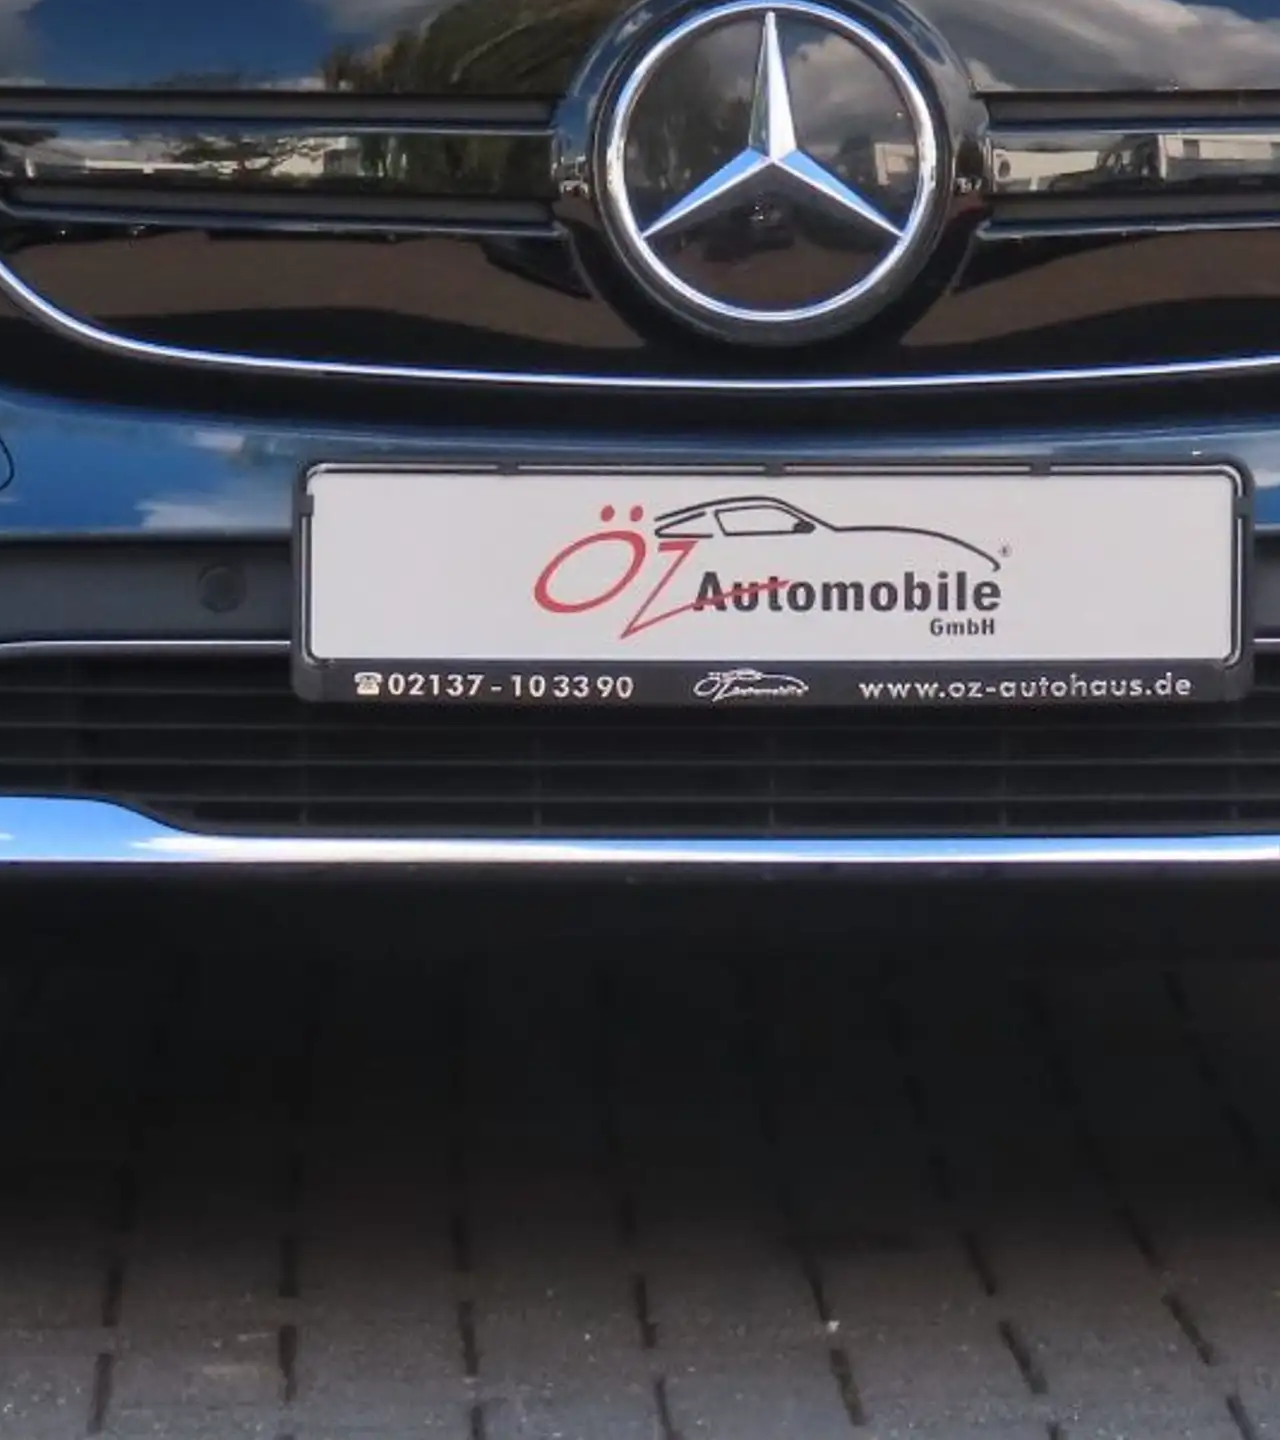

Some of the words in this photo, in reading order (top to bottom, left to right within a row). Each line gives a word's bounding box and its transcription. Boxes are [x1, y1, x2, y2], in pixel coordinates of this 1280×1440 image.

[692, 571, 1002, 612] Automobile
[929, 617, 995, 637] GmbH
[858, 671, 1193, 699] www.oz-autohaus.de
